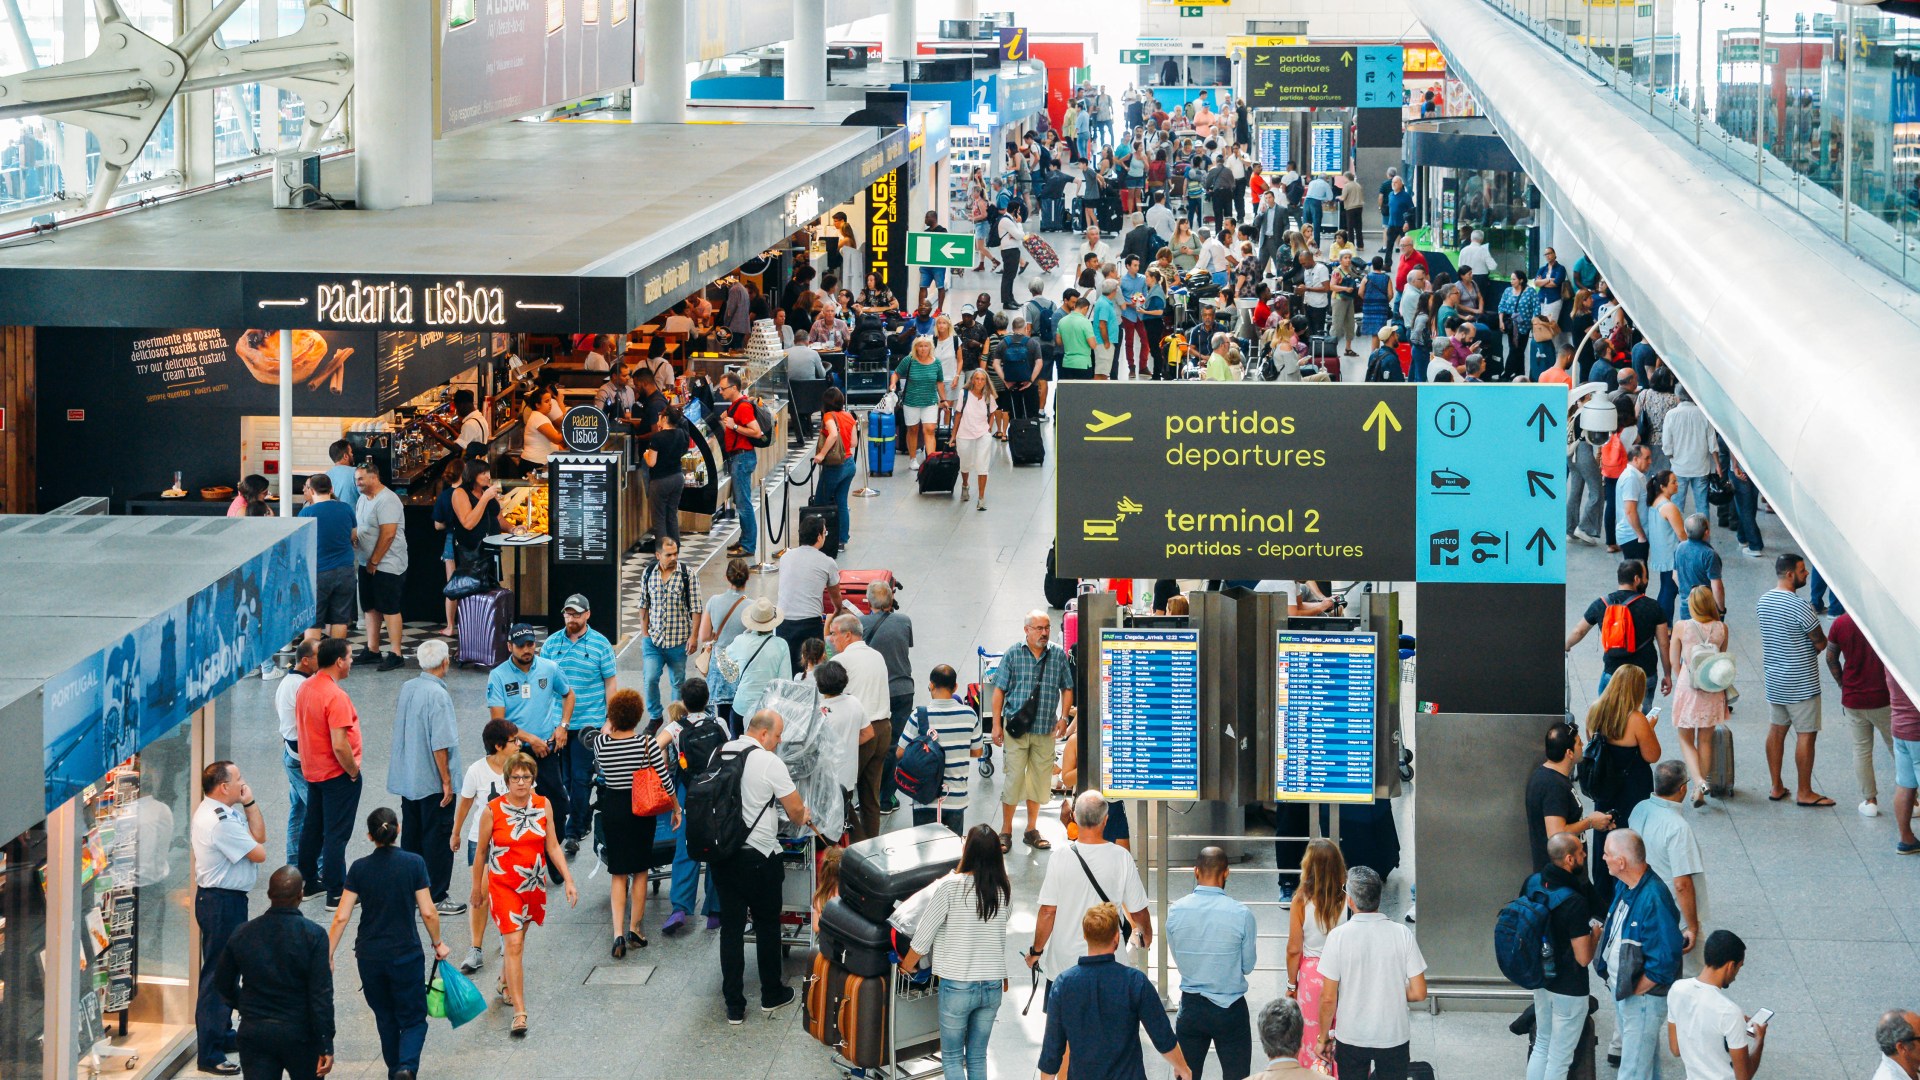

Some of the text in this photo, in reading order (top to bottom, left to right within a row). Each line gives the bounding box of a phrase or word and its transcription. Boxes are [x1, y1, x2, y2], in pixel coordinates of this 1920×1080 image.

[1279, 54, 1320, 64] partidas
[1280, 65, 1330, 74] departures
[1279, 84, 1328, 93] terminal 2
[131, 338, 230, 362] deliciosos pastéis de nata.
[133, 328, 221, 351] Experimente os nossos
[150, 362, 163, 373] our
[164, 356, 198, 371] delicious
[199, 351, 227, 365] custard
[162, 366, 207, 382] cream tarts.
[1165, 410, 1296, 440] partidas
[1165, 443, 1326, 471] departures
[1165, 508, 1320, 533] terminal 2
[1165, 540, 1241, 558] partidas
[1257, 541, 1364, 560] departures
[1432, 537, 1457, 545] metro
[186, 634, 246, 702] LISBON
[50, 669, 98, 709] PORTUGAL
